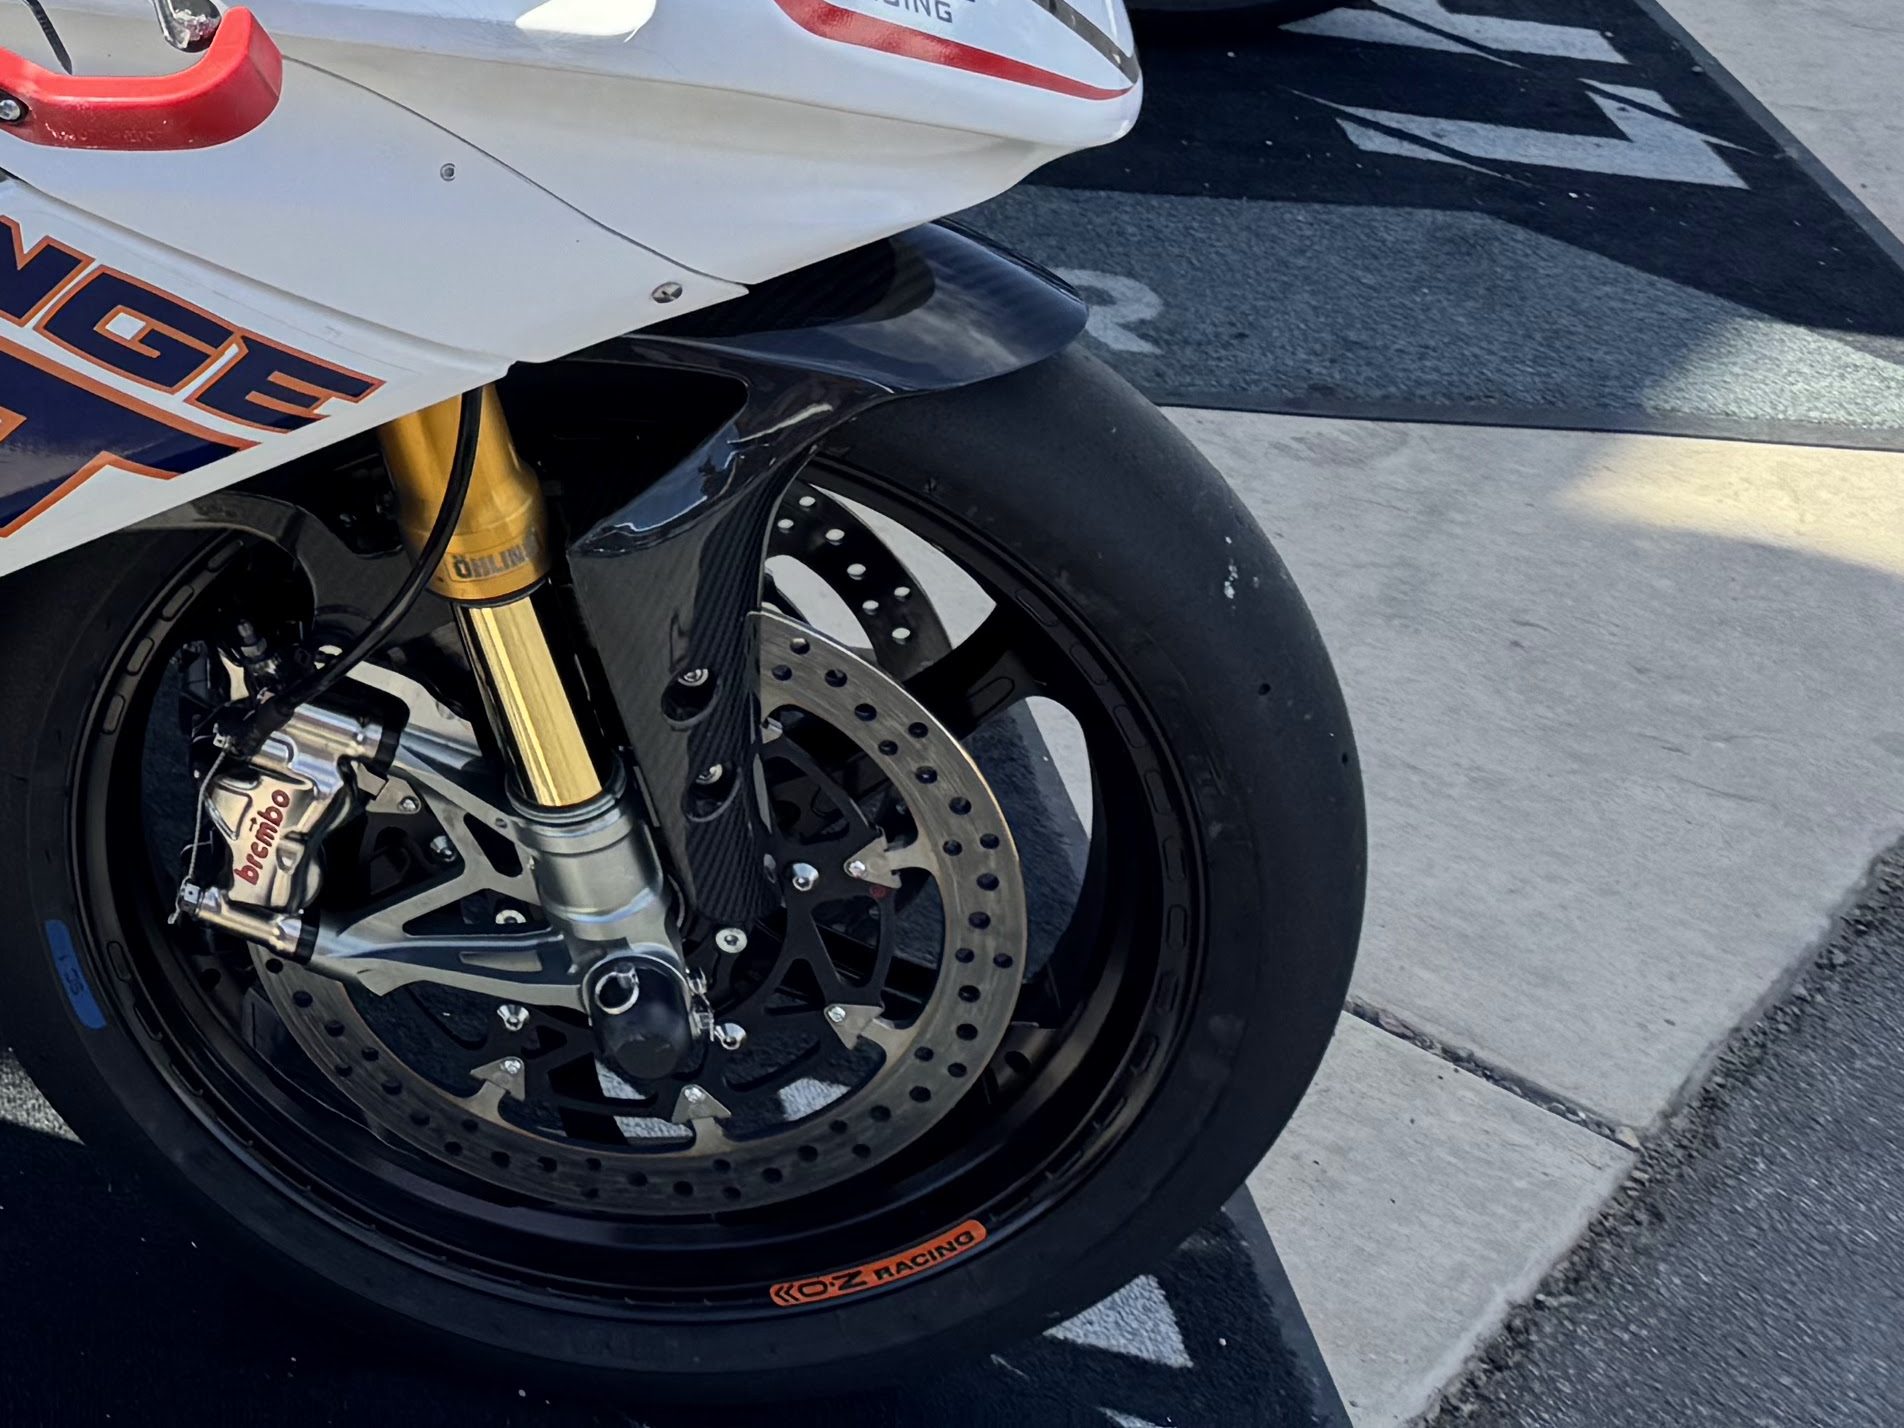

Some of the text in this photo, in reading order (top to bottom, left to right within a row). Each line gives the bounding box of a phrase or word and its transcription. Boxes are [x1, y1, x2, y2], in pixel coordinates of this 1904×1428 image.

[452, 541, 527, 581] ÖHLIN
[233, 788, 291, 886] brembo
[873, 1229, 975, 1282] RACING
